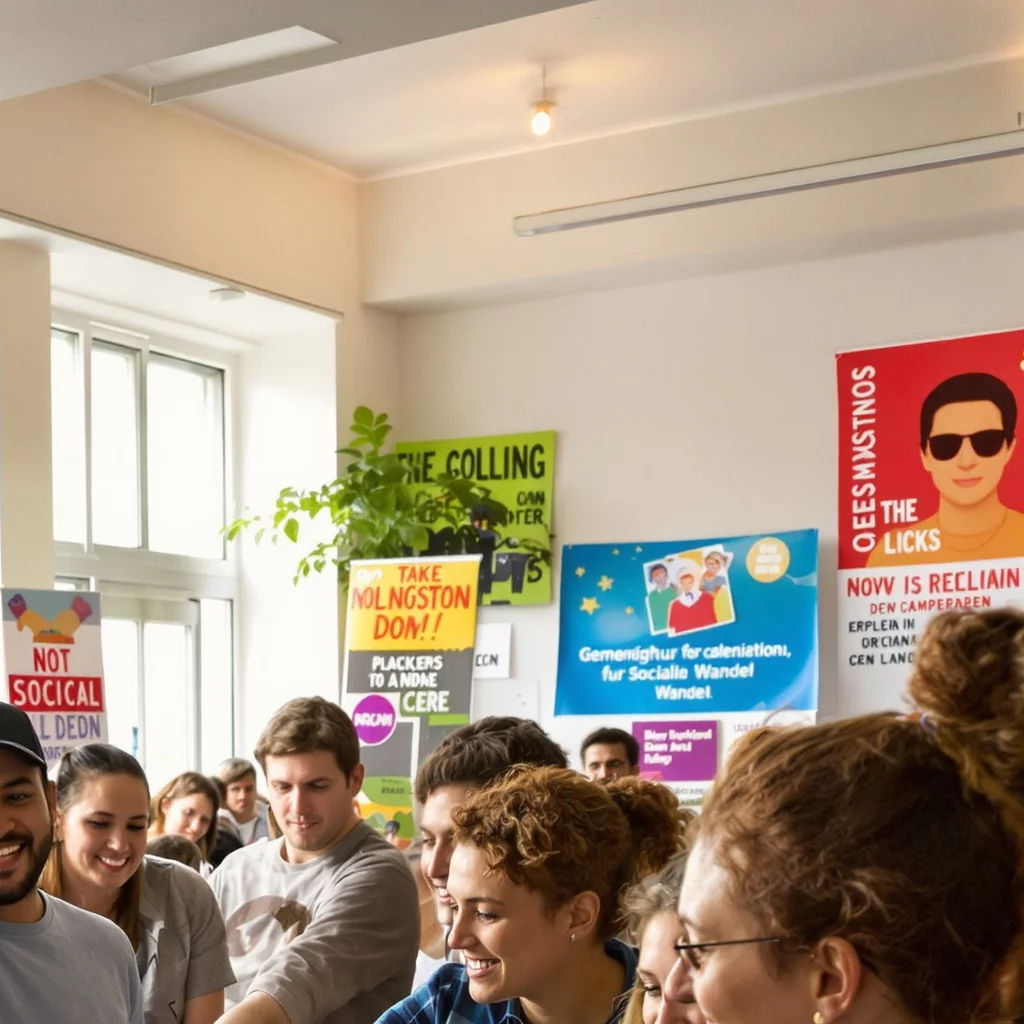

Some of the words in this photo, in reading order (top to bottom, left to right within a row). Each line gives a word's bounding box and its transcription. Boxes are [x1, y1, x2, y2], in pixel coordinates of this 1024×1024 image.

[880, 498, 918, 525] THE
[884, 528, 941, 555] LICKS
[398, 565, 442, 583] TAKE
[904, 575, 922, 595] IS
[869, 602, 896, 616] DEN
[903, 618, 915, 630] IN
[33, 647, 71, 673] NOT
[368, 672, 384, 688] TO
[694, 662, 754, 680] Wandel
[13, 679, 100, 708] SOCICAL
[402, 690, 450, 713] CERE
